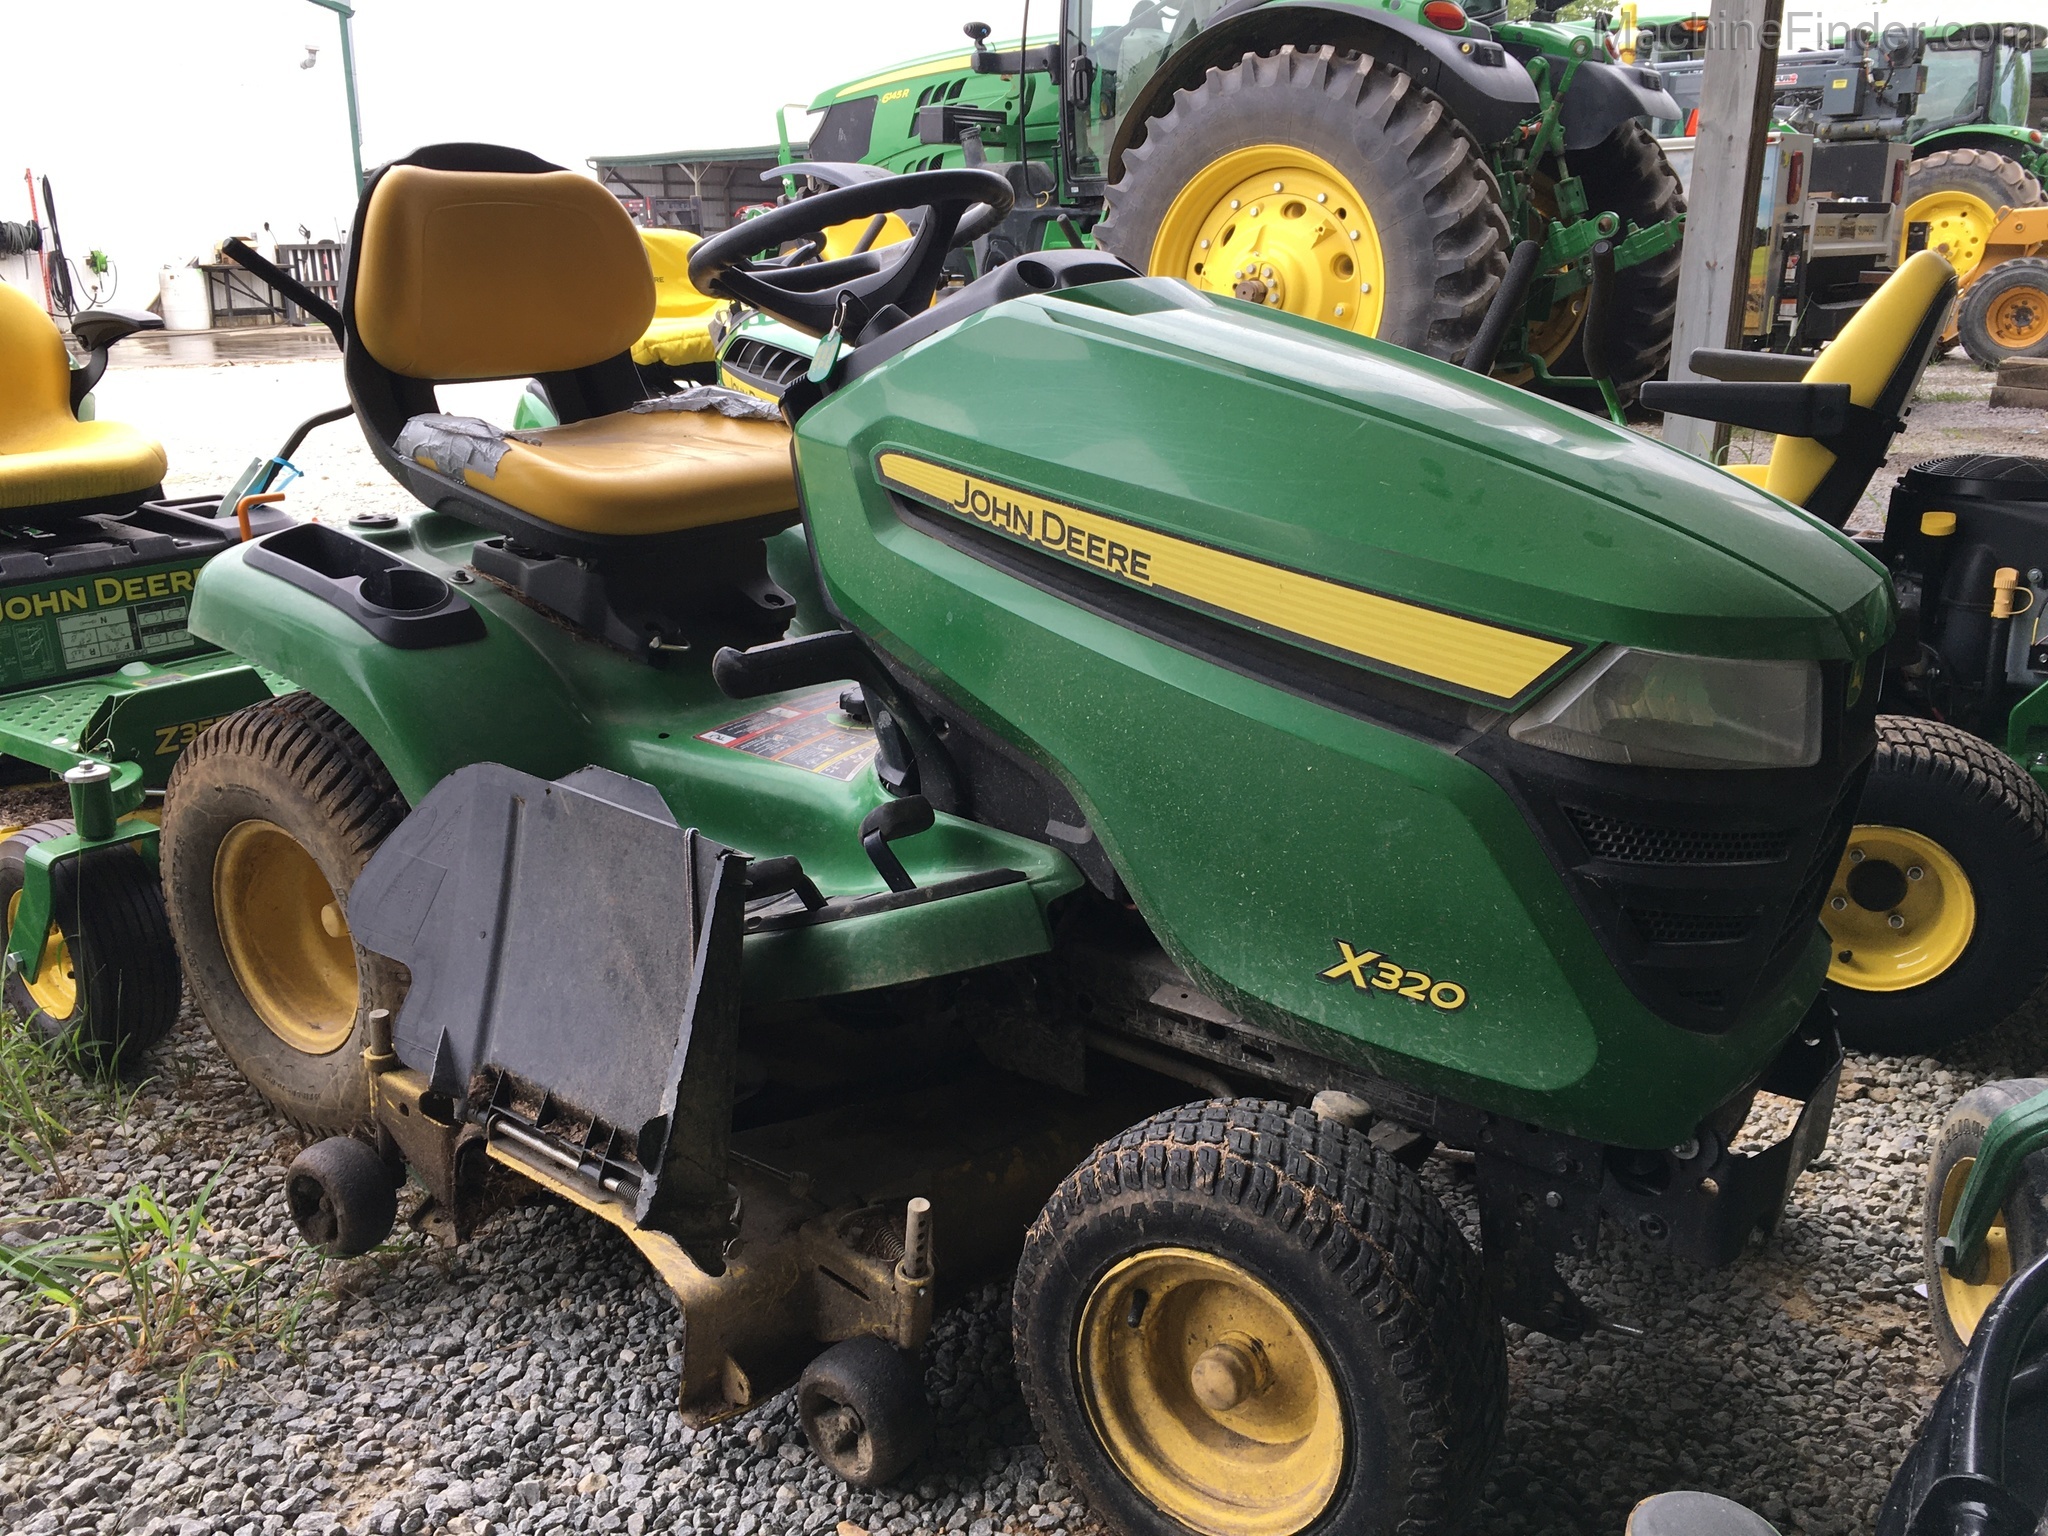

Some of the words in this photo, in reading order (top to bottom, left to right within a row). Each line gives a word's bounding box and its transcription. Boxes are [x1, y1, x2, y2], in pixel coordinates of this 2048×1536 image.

[953, 479, 1034, 537] JOHN
[1041, 509, 1153, 581] DEERE
[0, 586, 88, 622] OHN
[94, 570, 199, 606] DEER
[1320, 939, 1468, 1012] X320
